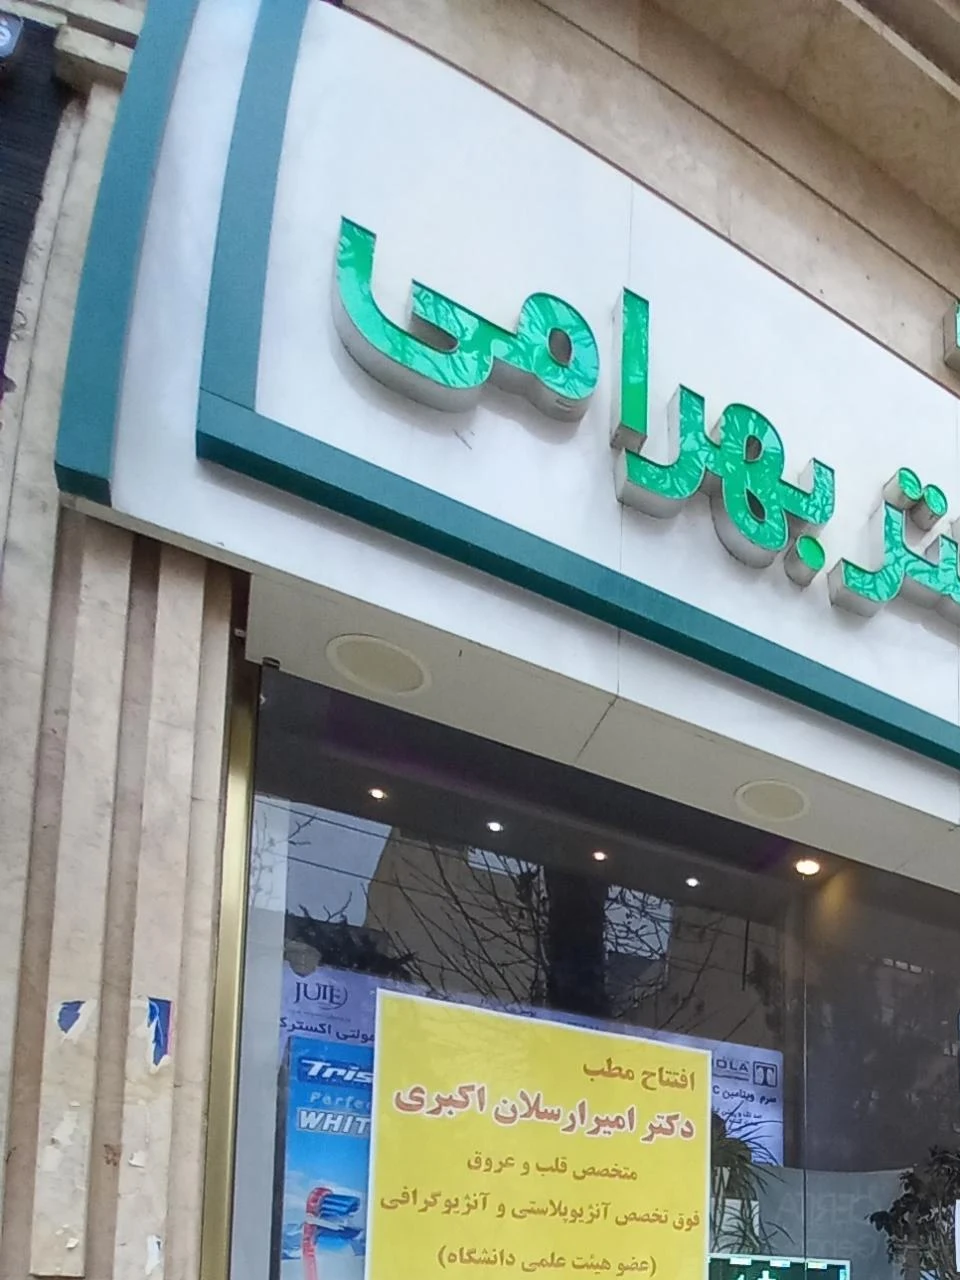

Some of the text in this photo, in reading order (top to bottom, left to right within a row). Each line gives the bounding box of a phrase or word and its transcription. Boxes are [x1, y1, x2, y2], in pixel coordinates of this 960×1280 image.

[334, 215, 836, 573] بهرامی
[301, 1059, 374, 1084] Tris
[583, 1057, 695, 1091] افتتاح مطب
[712, 1058, 749, 1074] OLA
[310, 1092, 371, 1110] Perfe
[393, 1083, 487, 1117] اکبری
[299, 1110, 371, 1135] WHIT
[640, 1112, 696, 1143] دکتر
[467, 1151, 639, 1181] متخصص قلب و عروق
[380, 1186, 700, 1231] فوق تخصص آنژیوپلاستی و آنژیوگرافی
[437, 1244, 657, 1277] (عضو هیئت علمی دانشگاه)
